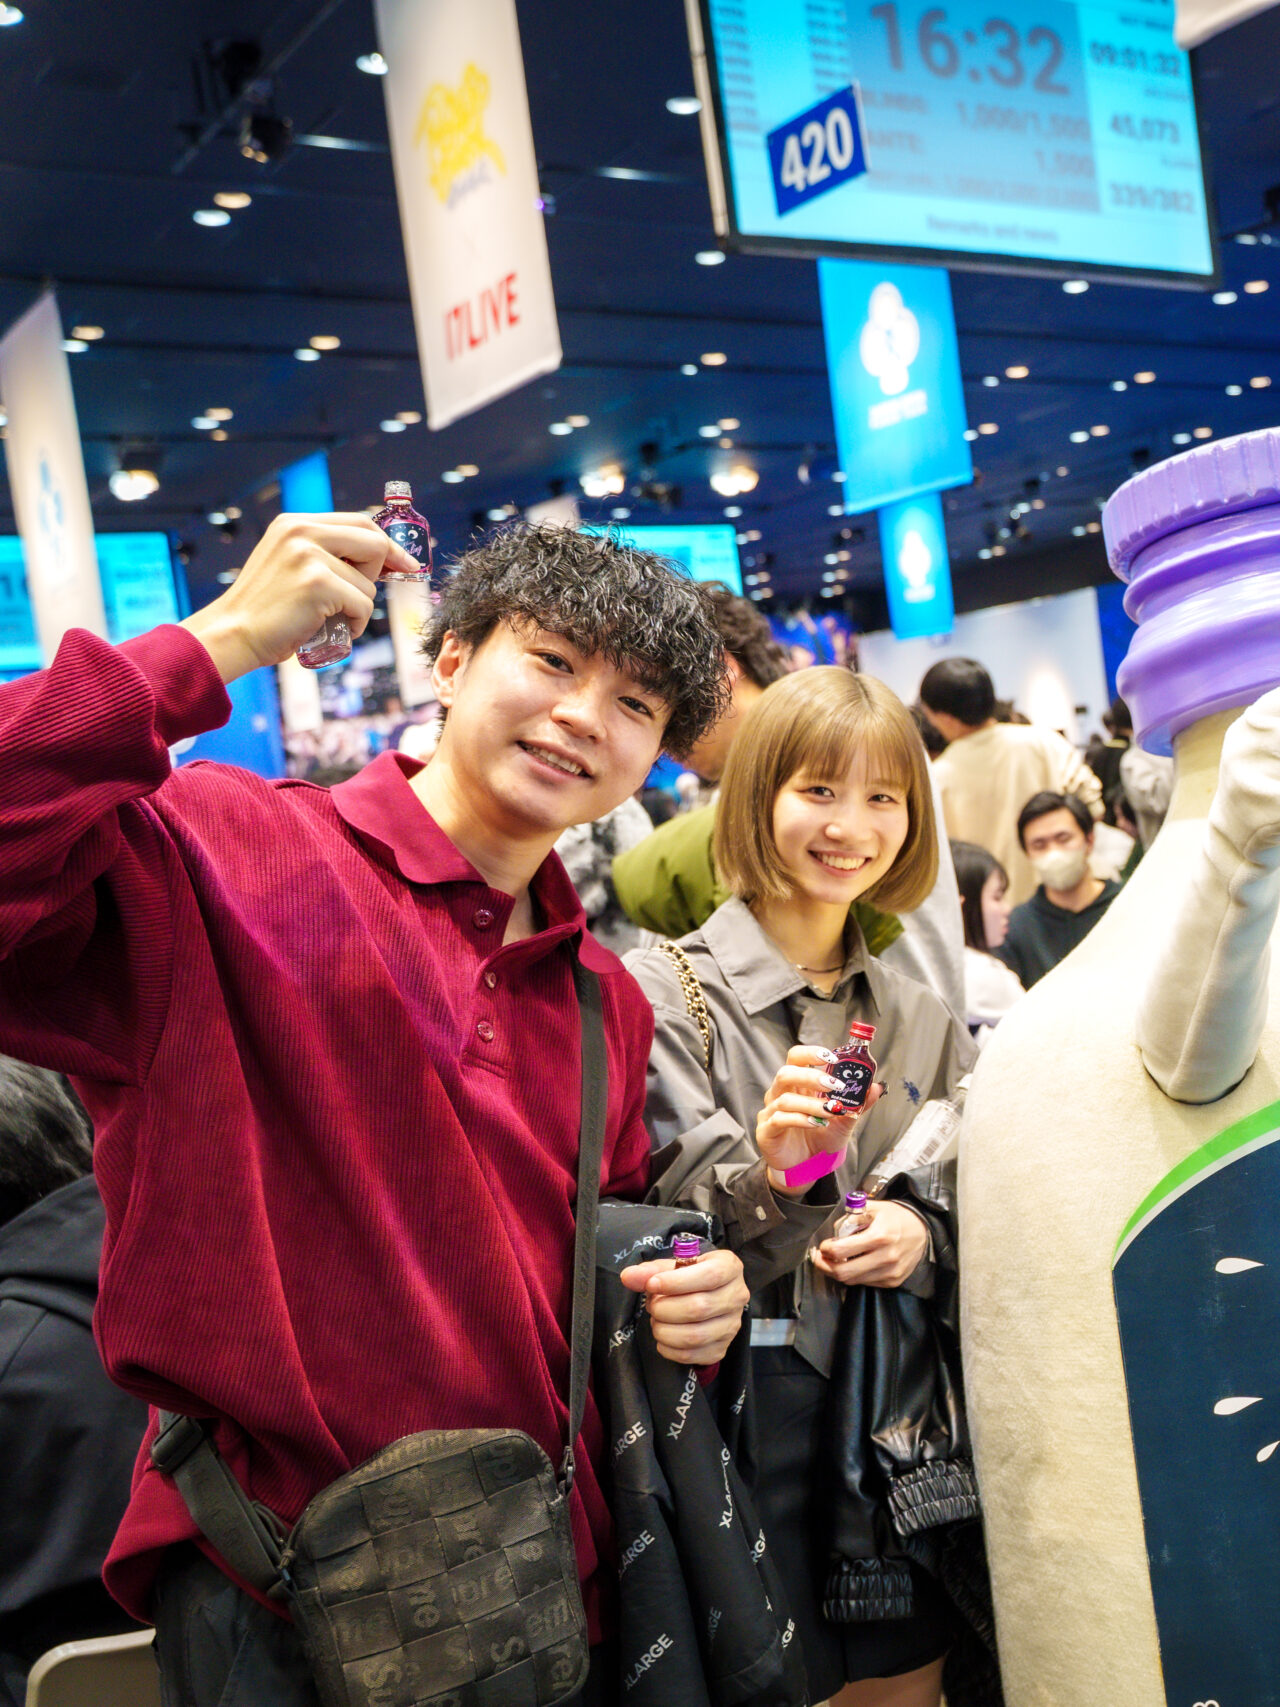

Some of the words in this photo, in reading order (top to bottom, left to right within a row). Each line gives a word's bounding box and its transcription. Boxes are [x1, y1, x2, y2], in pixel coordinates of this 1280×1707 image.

[871, 2, 1070, 96] 16:32
[781, 108, 854, 192] 420
[444, 272, 520, 362] 17LIVE
[666, 1368, 698, 1440] XLARGE
